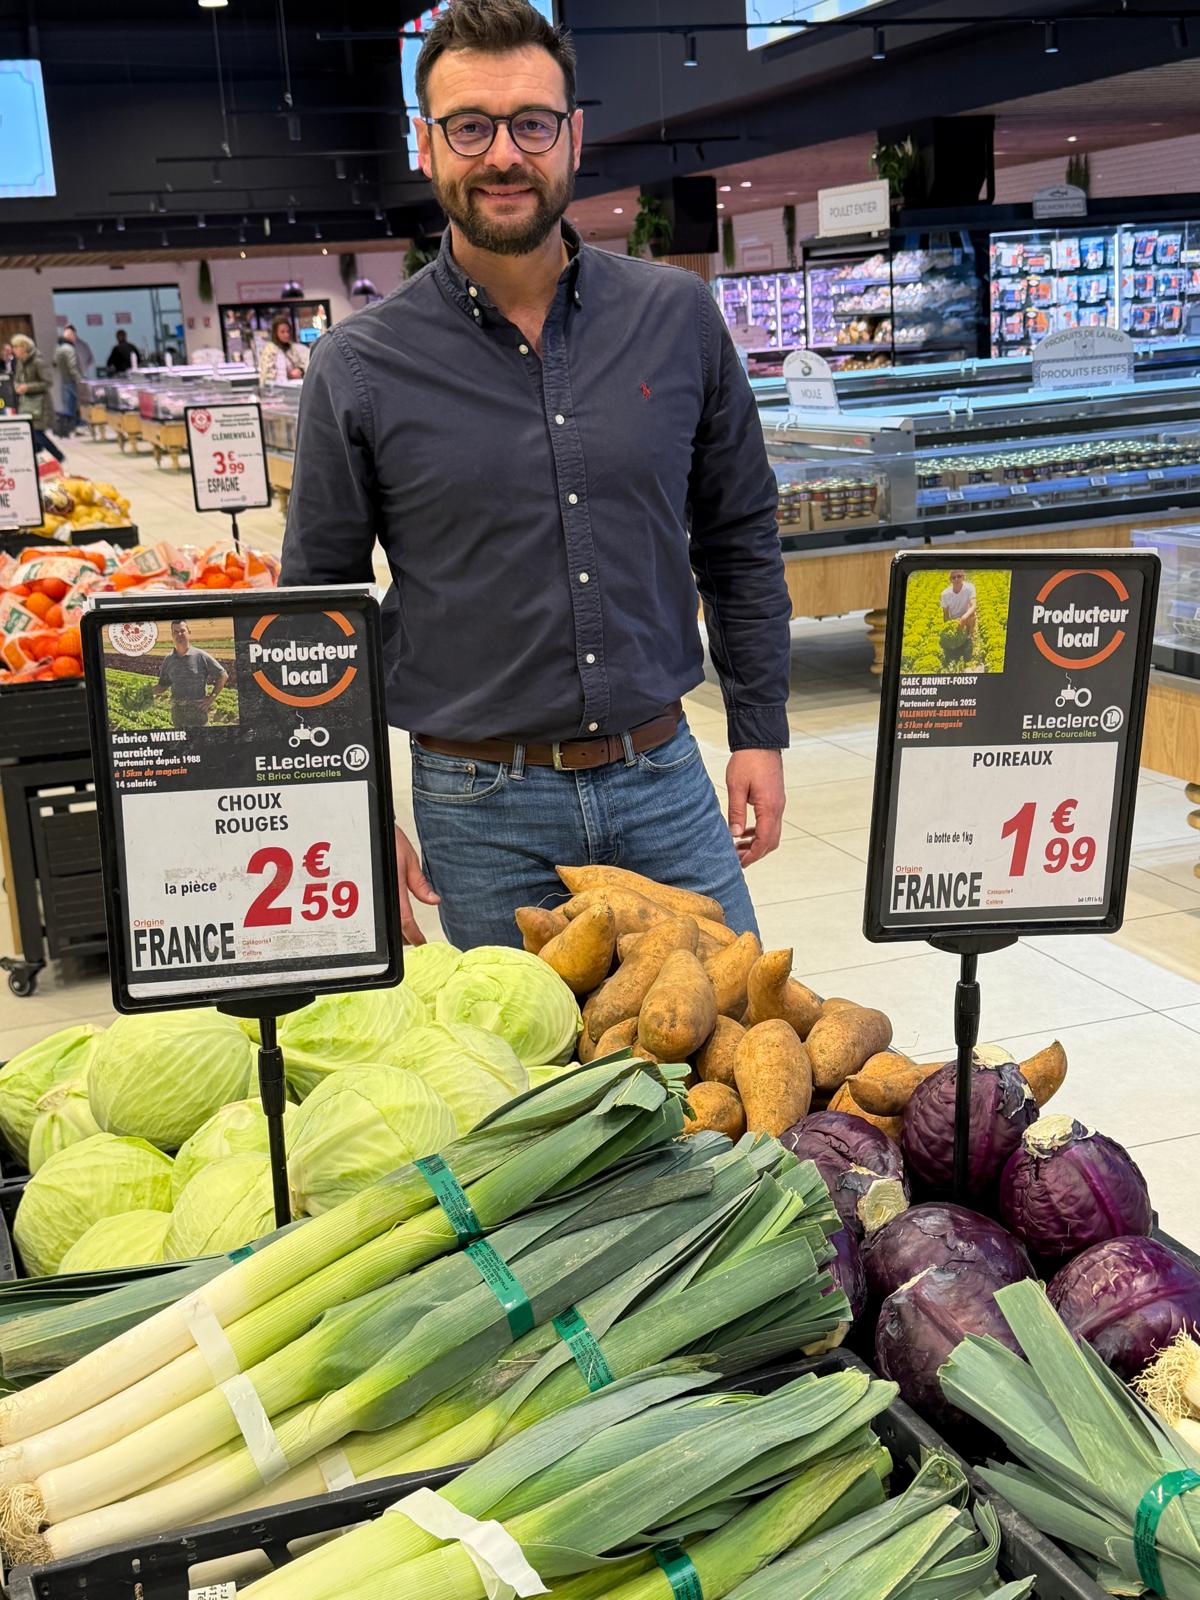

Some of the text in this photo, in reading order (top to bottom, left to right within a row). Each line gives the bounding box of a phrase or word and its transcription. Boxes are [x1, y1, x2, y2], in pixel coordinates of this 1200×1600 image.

[830, 204, 853, 218] POULET
[1044, 330, 1083, 350] PRODUITS
[1084, 330, 1094, 338] DE
[1041, 364, 1127, 379] PRODUITS FESTIFS
[212, 451, 226, 475] 3
[229, 462, 245, 474] 99
[208, 476, 240, 493] ESPAGNE
[1032, 603, 1129, 624] Producteur
[1057, 626, 1100, 648] local
[249, 640, 358, 663] Producteur
[281, 664, 328, 686] local
[902, 676, 978, 686] GAEC BRUNET-FOISSY
[900, 700, 934, 708] Partenaire
[936, 699, 958, 708] depuis
[924, 720, 933, 728] du
[934, 720, 963, 730] magasin
[1022, 714, 1098, 730] E.Leclerc
[112, 731, 186, 744] Fabrice WATIER
[903, 730, 930, 739] salariés
[1022, 729, 1097, 740] St Brice Courcelles
[114, 755, 201, 768] Partenaire depuis 1988
[255, 752, 342, 771] E.Leclerc
[972, 750, 1053, 768] POIREAUX
[122, 768, 142, 778] 15km
[144, 768, 154, 776] du
[156, 766, 188, 777] magasin
[256, 769, 342, 782] St Brice Courcelles
[126, 778, 157, 788] salariés
[217, 792, 282, 812] CHOUX
[215, 815, 288, 834] ROUGES
[926, 831, 974, 846] la botte de 1kg
[1001, 798, 1096, 877] 1 € 99
[896, 864, 922, 873] Origine
[164, 880, 218, 896] la pièce
[243, 842, 359, 928] 2 € 59
[892, 872, 982, 911] FRANCE
[134, 918, 164, 928] Origine
[134, 922, 236, 968] FRANCE
